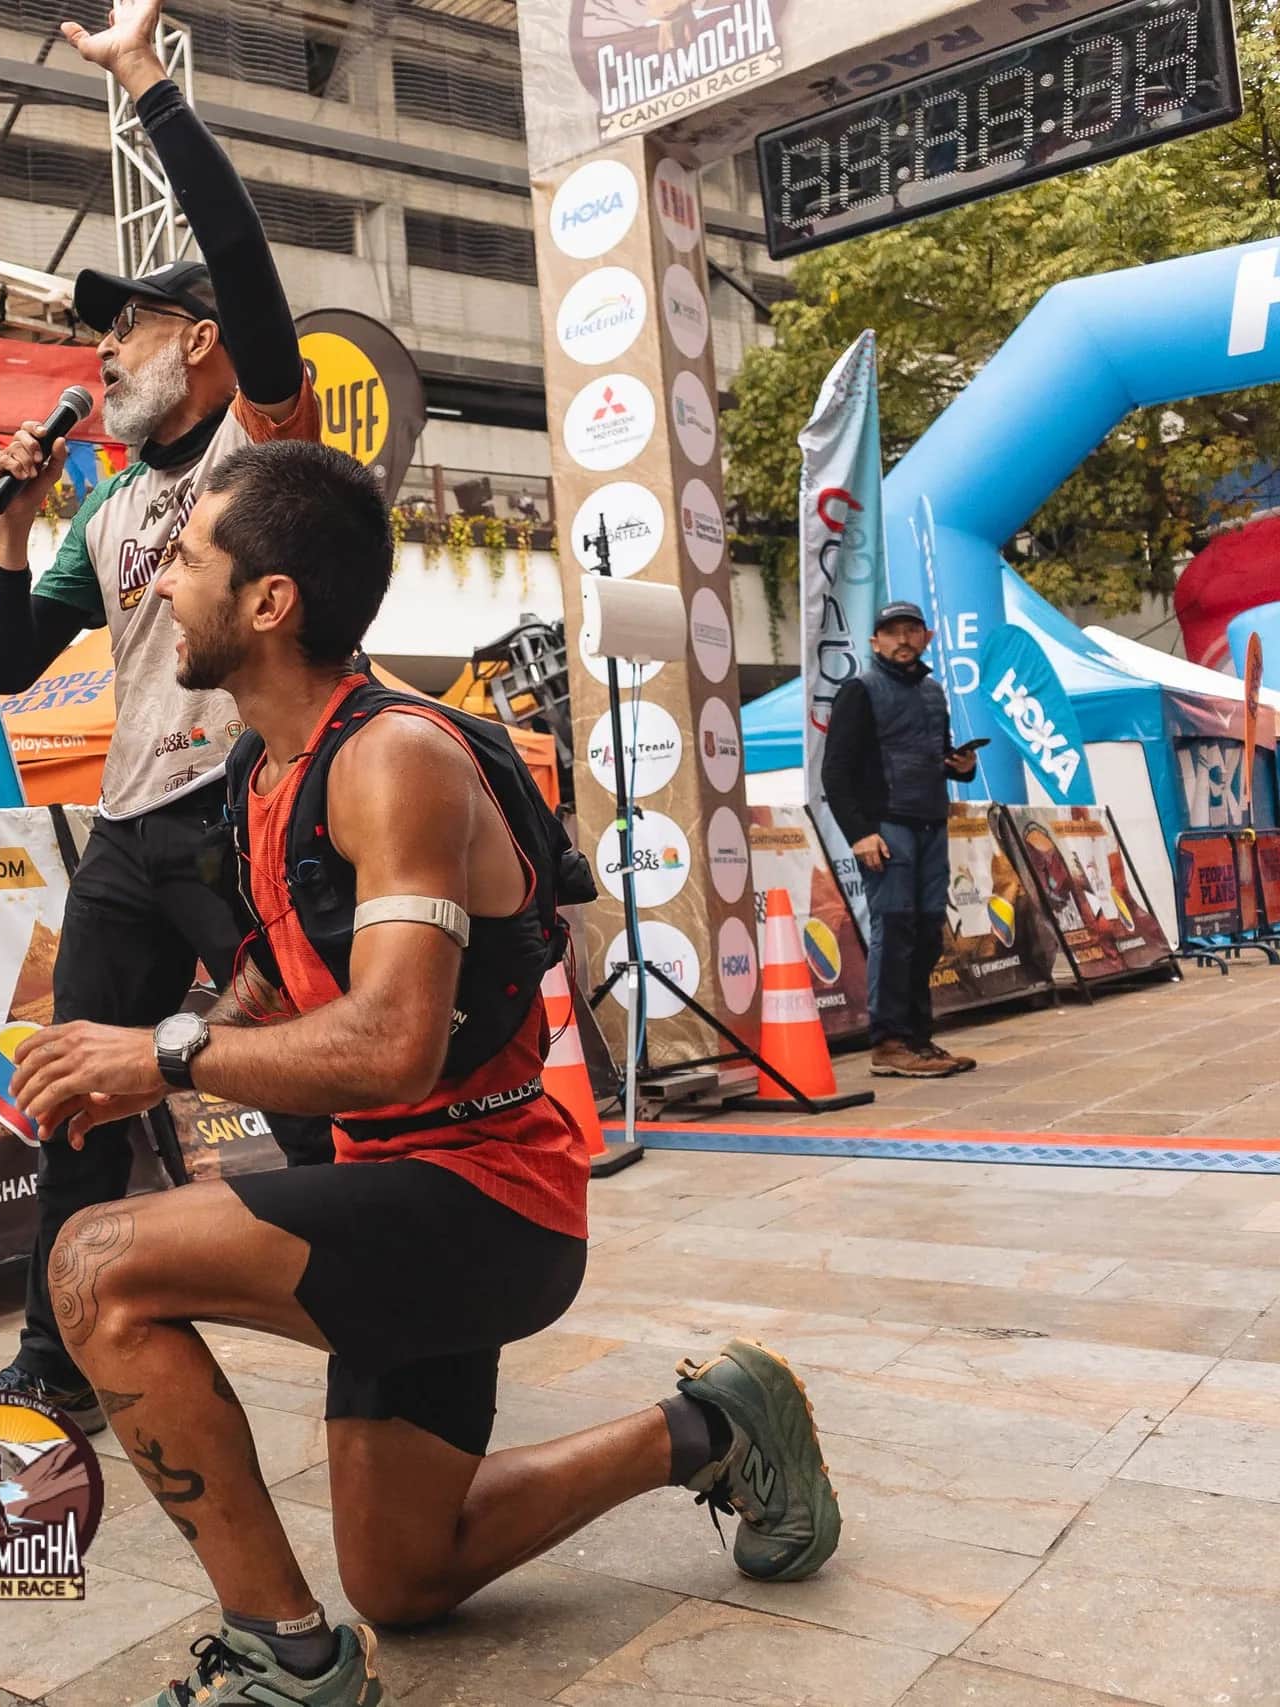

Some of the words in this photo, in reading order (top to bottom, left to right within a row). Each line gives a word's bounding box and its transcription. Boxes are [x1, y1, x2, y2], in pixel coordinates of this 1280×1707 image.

[598, 0, 776, 114] CHICAMOCHA
[619, 86, 701, 129] CANYON
[706, 62, 761, 93] RACE
[560, 191, 624, 231] HOKA
[564, 307, 636, 340] Electrolit
[991, 667, 1081, 794] HOKA
[722, 954, 750, 976] HOKA
[197, 1115, 246, 1145] SAN
[239, 1111, 272, 1137] GIL
